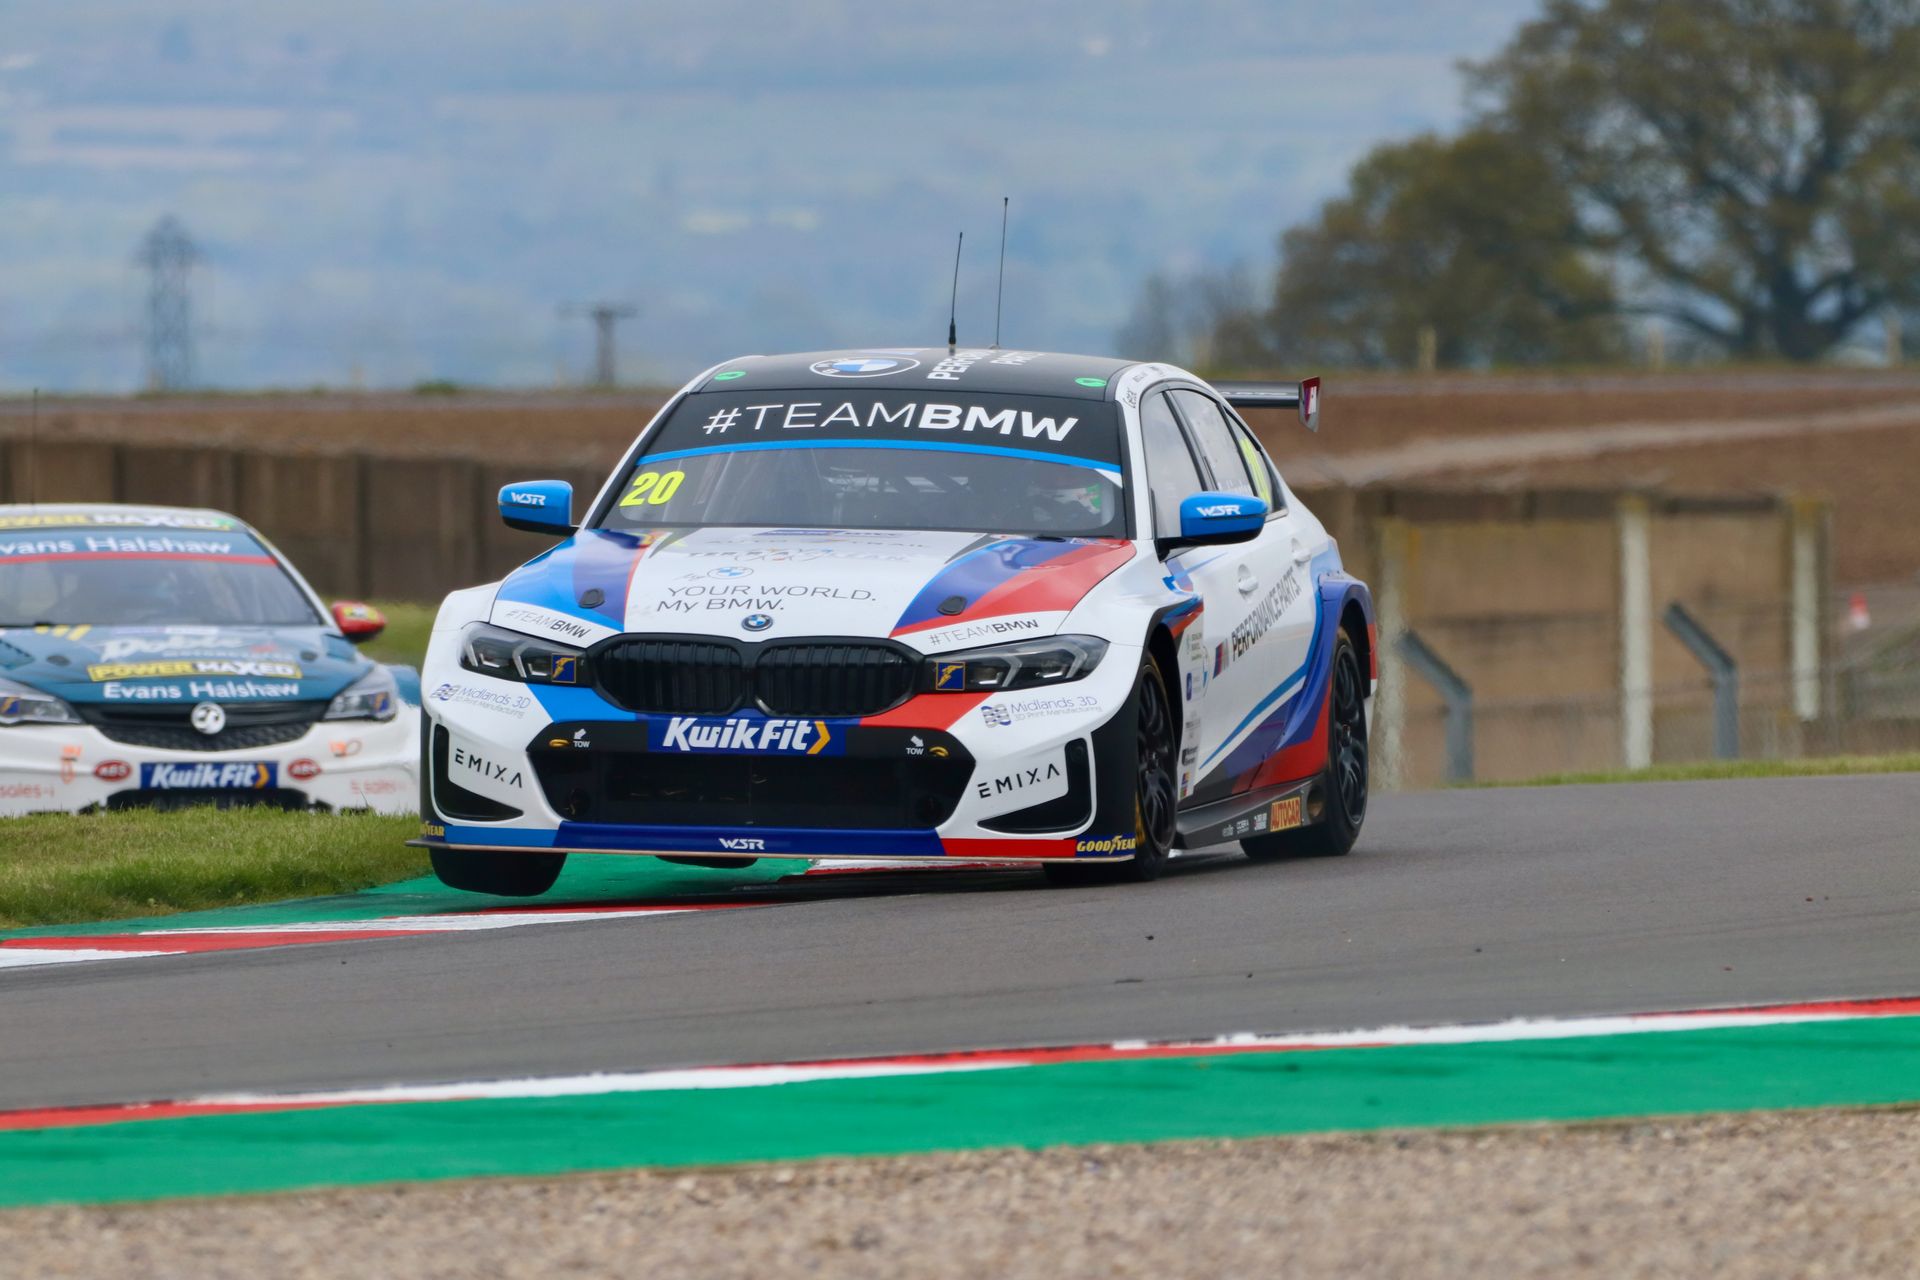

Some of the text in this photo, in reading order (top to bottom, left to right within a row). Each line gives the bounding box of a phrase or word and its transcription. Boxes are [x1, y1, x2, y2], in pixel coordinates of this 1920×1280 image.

[702, 402, 1078, 441] #TEAMBMW
[619, 471, 685, 507] 20
[511, 492, 545, 506] WSR
[1196, 504, 1241, 517] WSR
[0, 537, 231, 554] vans Halshaw
[667, 585, 876, 602] YOUR WORLD.
[656, 599, 785, 613] My BMW.
[1231, 582, 1282, 662] PERFORMANCE
[1279, 565, 1302, 613] PARTS
[96, 661, 294, 678] POWER MAXED
[103, 681, 299, 699] Evans Halshaw
[458, 687, 511, 706] Midlands
[512, 696, 531, 709] 3D
[1011, 696, 1098, 714] Midlands 3D
[662, 717, 812, 751] KwikFit
[573, 740, 590, 748] TOW
[906, 746, 924, 755] TOW
[150, 763, 257, 788] KwikFit
[1271, 799, 1300, 830] AUTOCAR
[719, 838, 765, 850] WSR
[1077, 836, 1136, 854] GOODYEAR
